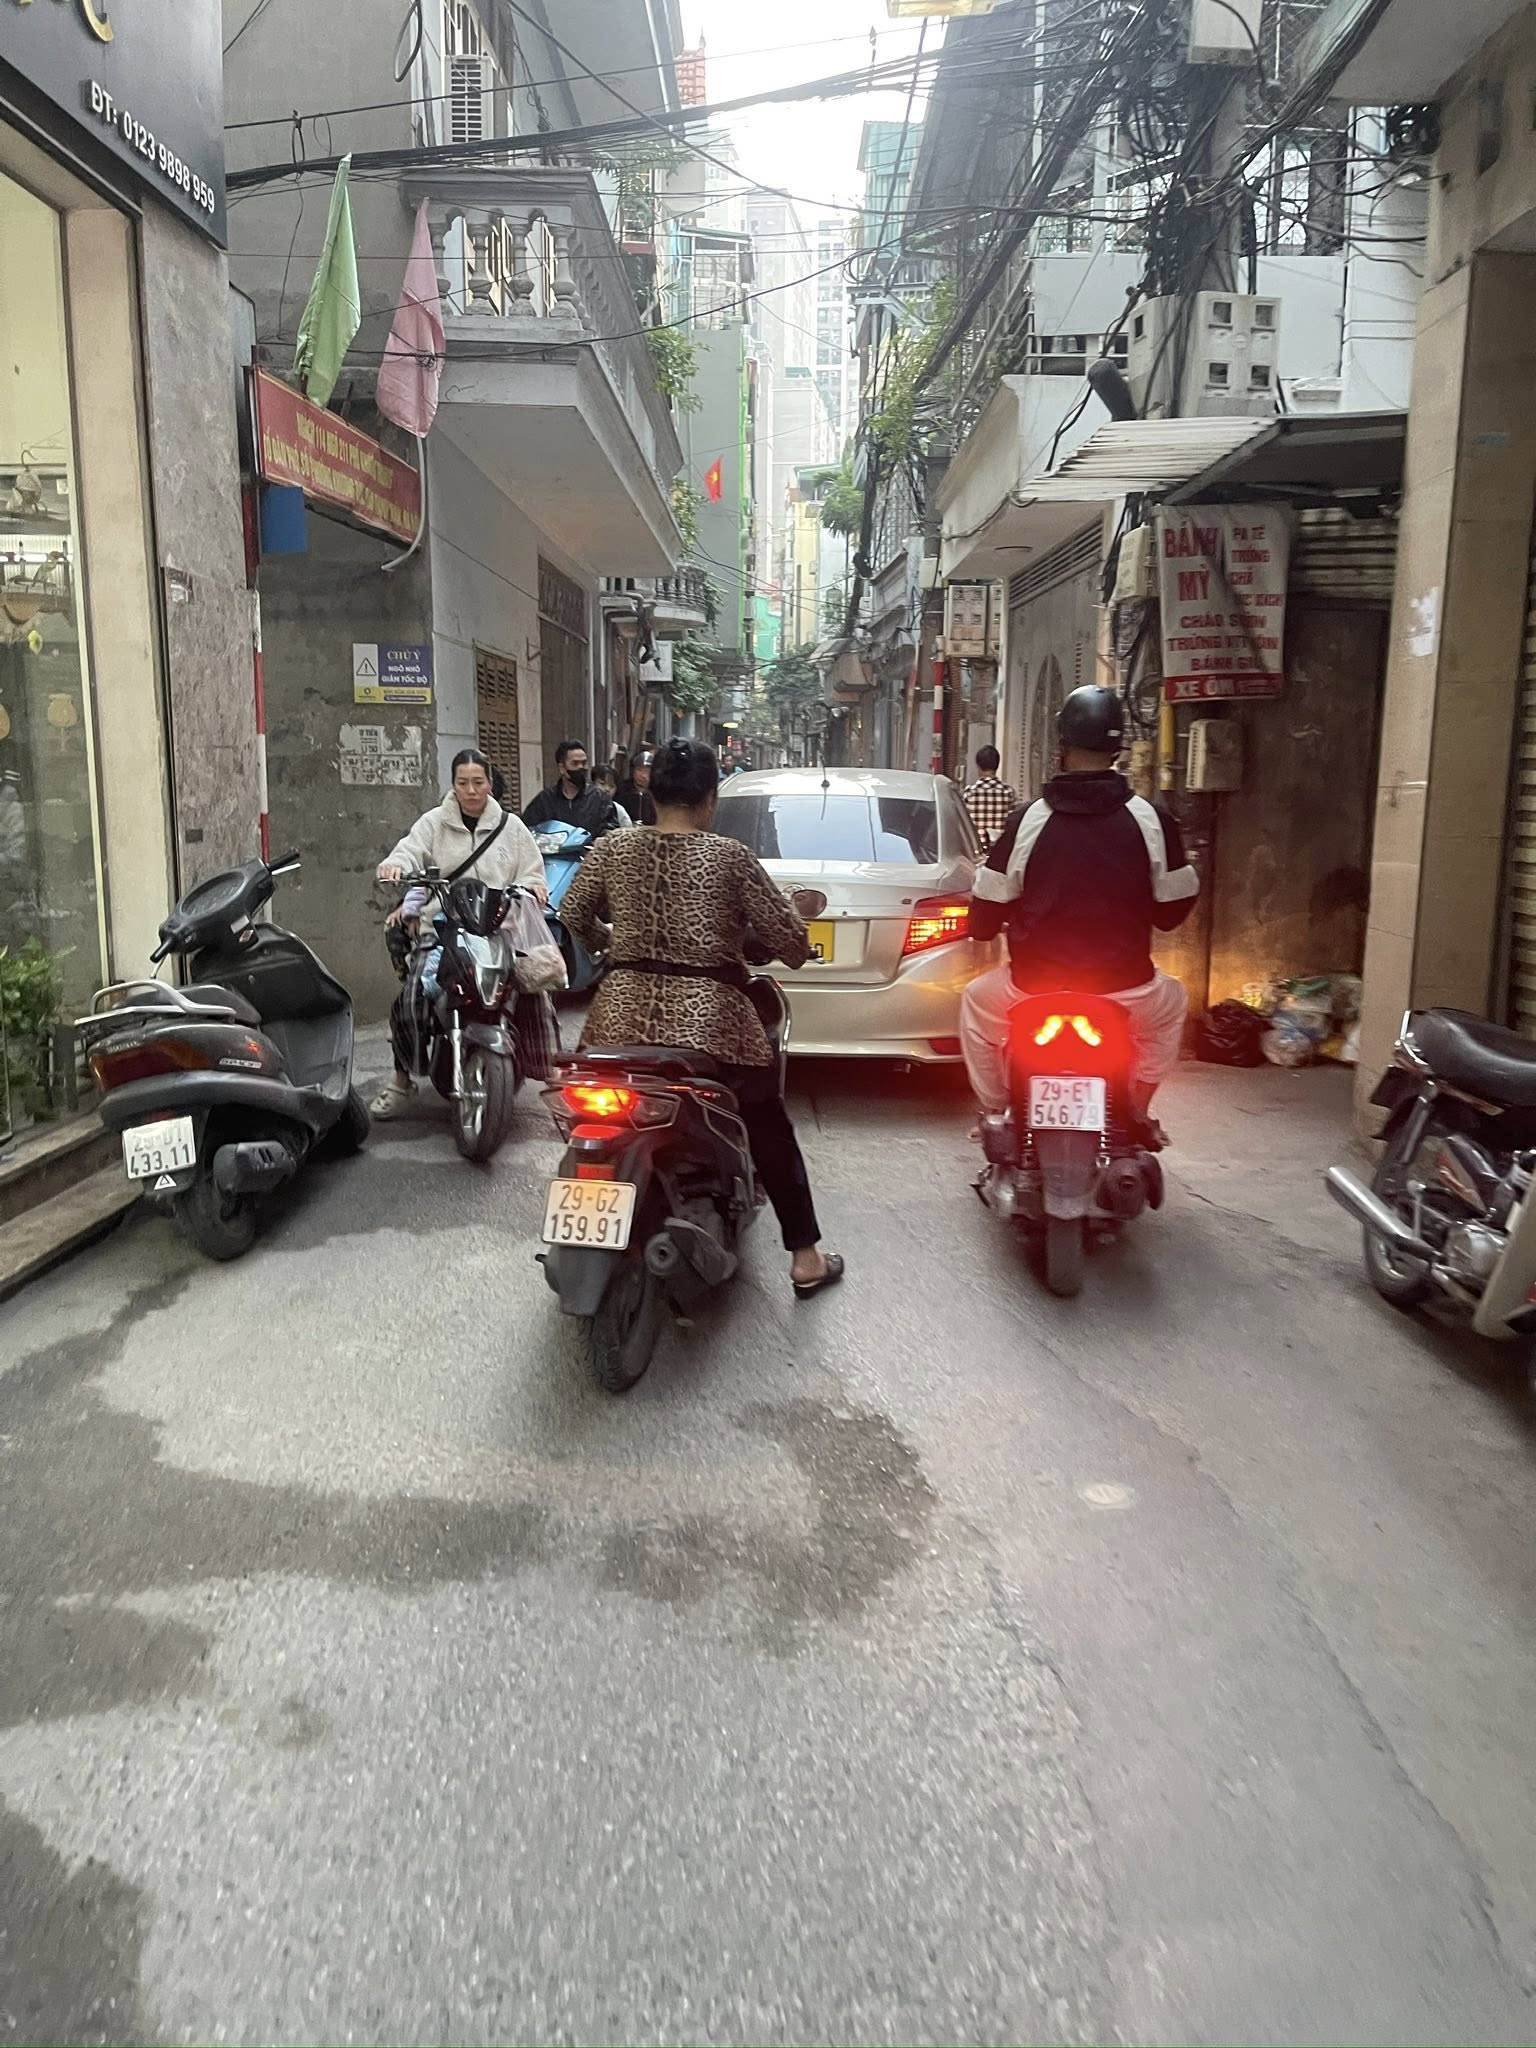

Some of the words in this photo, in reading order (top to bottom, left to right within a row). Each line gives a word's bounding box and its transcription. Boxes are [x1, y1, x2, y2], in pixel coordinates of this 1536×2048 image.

[91, 80, 117, 124] ĐT:
[123, 110, 156, 161] 0123
[159, 142, 191, 192] 9898
[193, 174, 215, 214] 959
[315, 423, 326, 453] 114
[1164, 520, 1218, 557] BÁNH
[1175, 681, 1200, 698] XE
[1040, 1080, 1091, 1102] 29-E1
[130, 1143, 191, 1176] 433.11
[559, 1184, 620, 1214] 29-G2
[551, 1213, 622, 1245] 159.91
